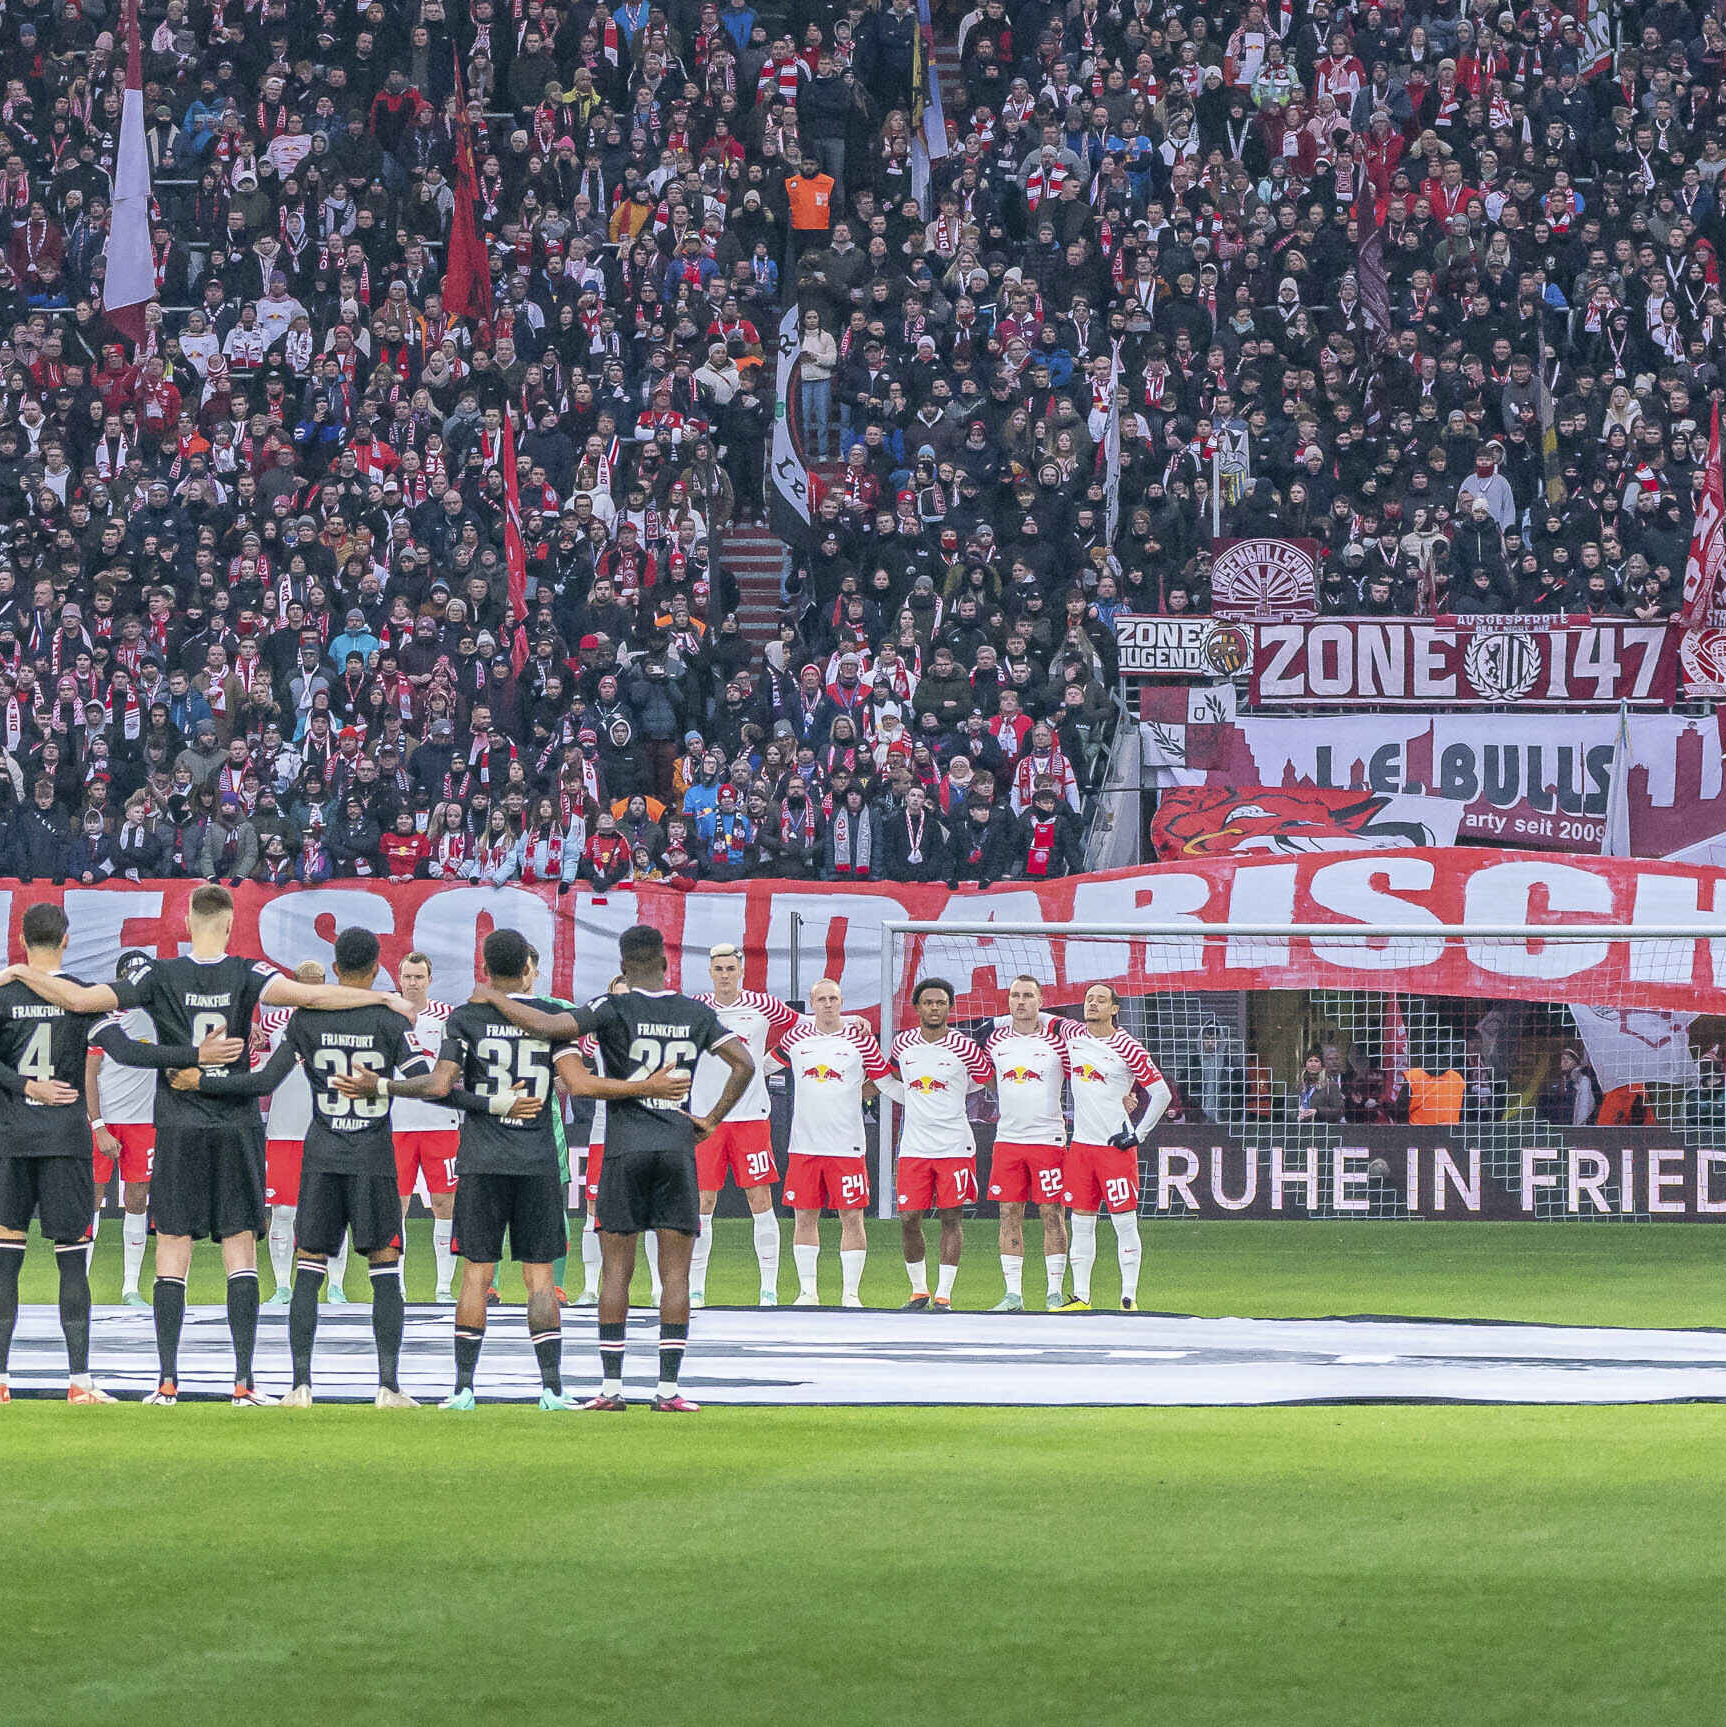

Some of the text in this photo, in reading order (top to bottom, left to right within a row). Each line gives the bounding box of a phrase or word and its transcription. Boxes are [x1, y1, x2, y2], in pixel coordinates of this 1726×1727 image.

[1116, 623, 1202, 648] ZONE
[1117, 647, 1201, 669] JUGEND
[1260, 623, 1458, 697] ZONE
[1547, 626, 1666, 700] 147
[1465, 812, 1503, 835] arty
[1513, 817, 1552, 838] seit
[321, 1033, 374, 1049] FRANKFURT
[486, 1024, 525, 1037] FRANK
[637, 1023, 691, 1038] FRANKFURT
[17, 1022, 55, 1082] 4
[476, 1036, 552, 1111] 35
[627, 1037, 698, 1104] 26
[746, 1150, 770, 1176] 30
[841, 1175, 865, 1200] 24
[953, 1170, 970, 1193] 17
[1039, 1168, 1063, 1192] 22
[1106, 1177, 1130, 1202] 20
[1158, 1146, 1371, 1211] RUHE
[1408, 1147, 1481, 1212] IN
